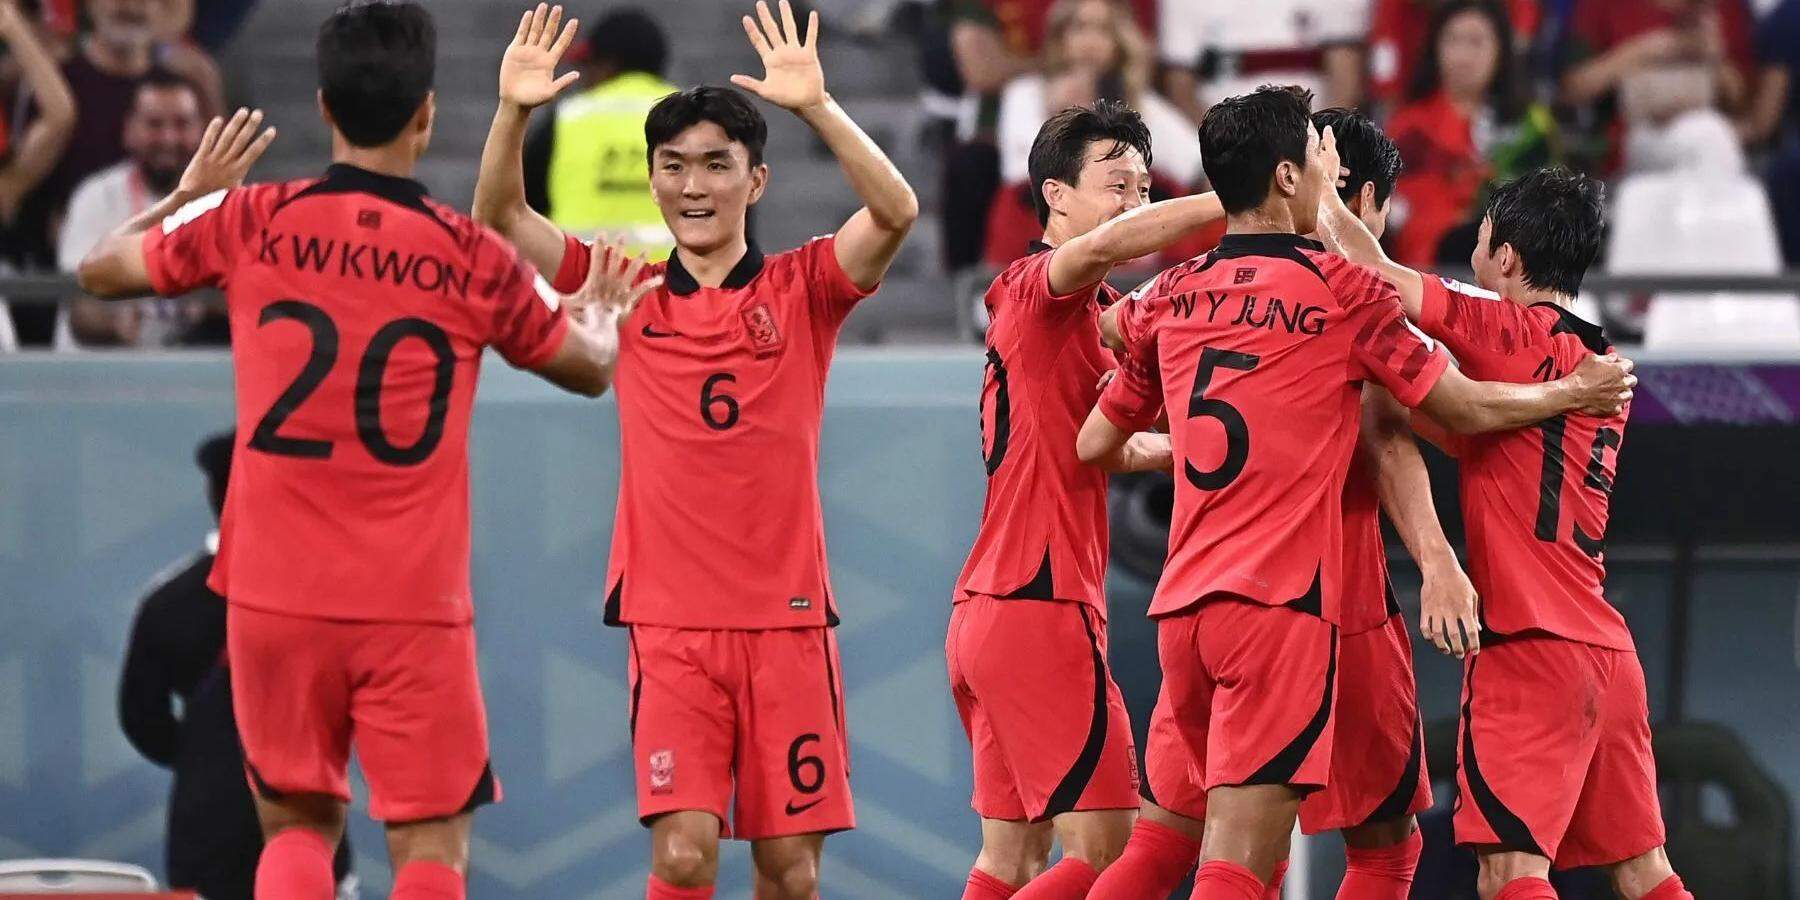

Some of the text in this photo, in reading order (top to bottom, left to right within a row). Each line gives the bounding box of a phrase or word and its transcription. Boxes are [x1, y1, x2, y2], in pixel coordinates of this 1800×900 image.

[1231, 294, 1328, 336] JUNG
[247, 299, 456, 468] 20
[700, 372, 739, 431] 6
[1184, 346, 1260, 491] 5
[787, 733, 825, 794] 6
